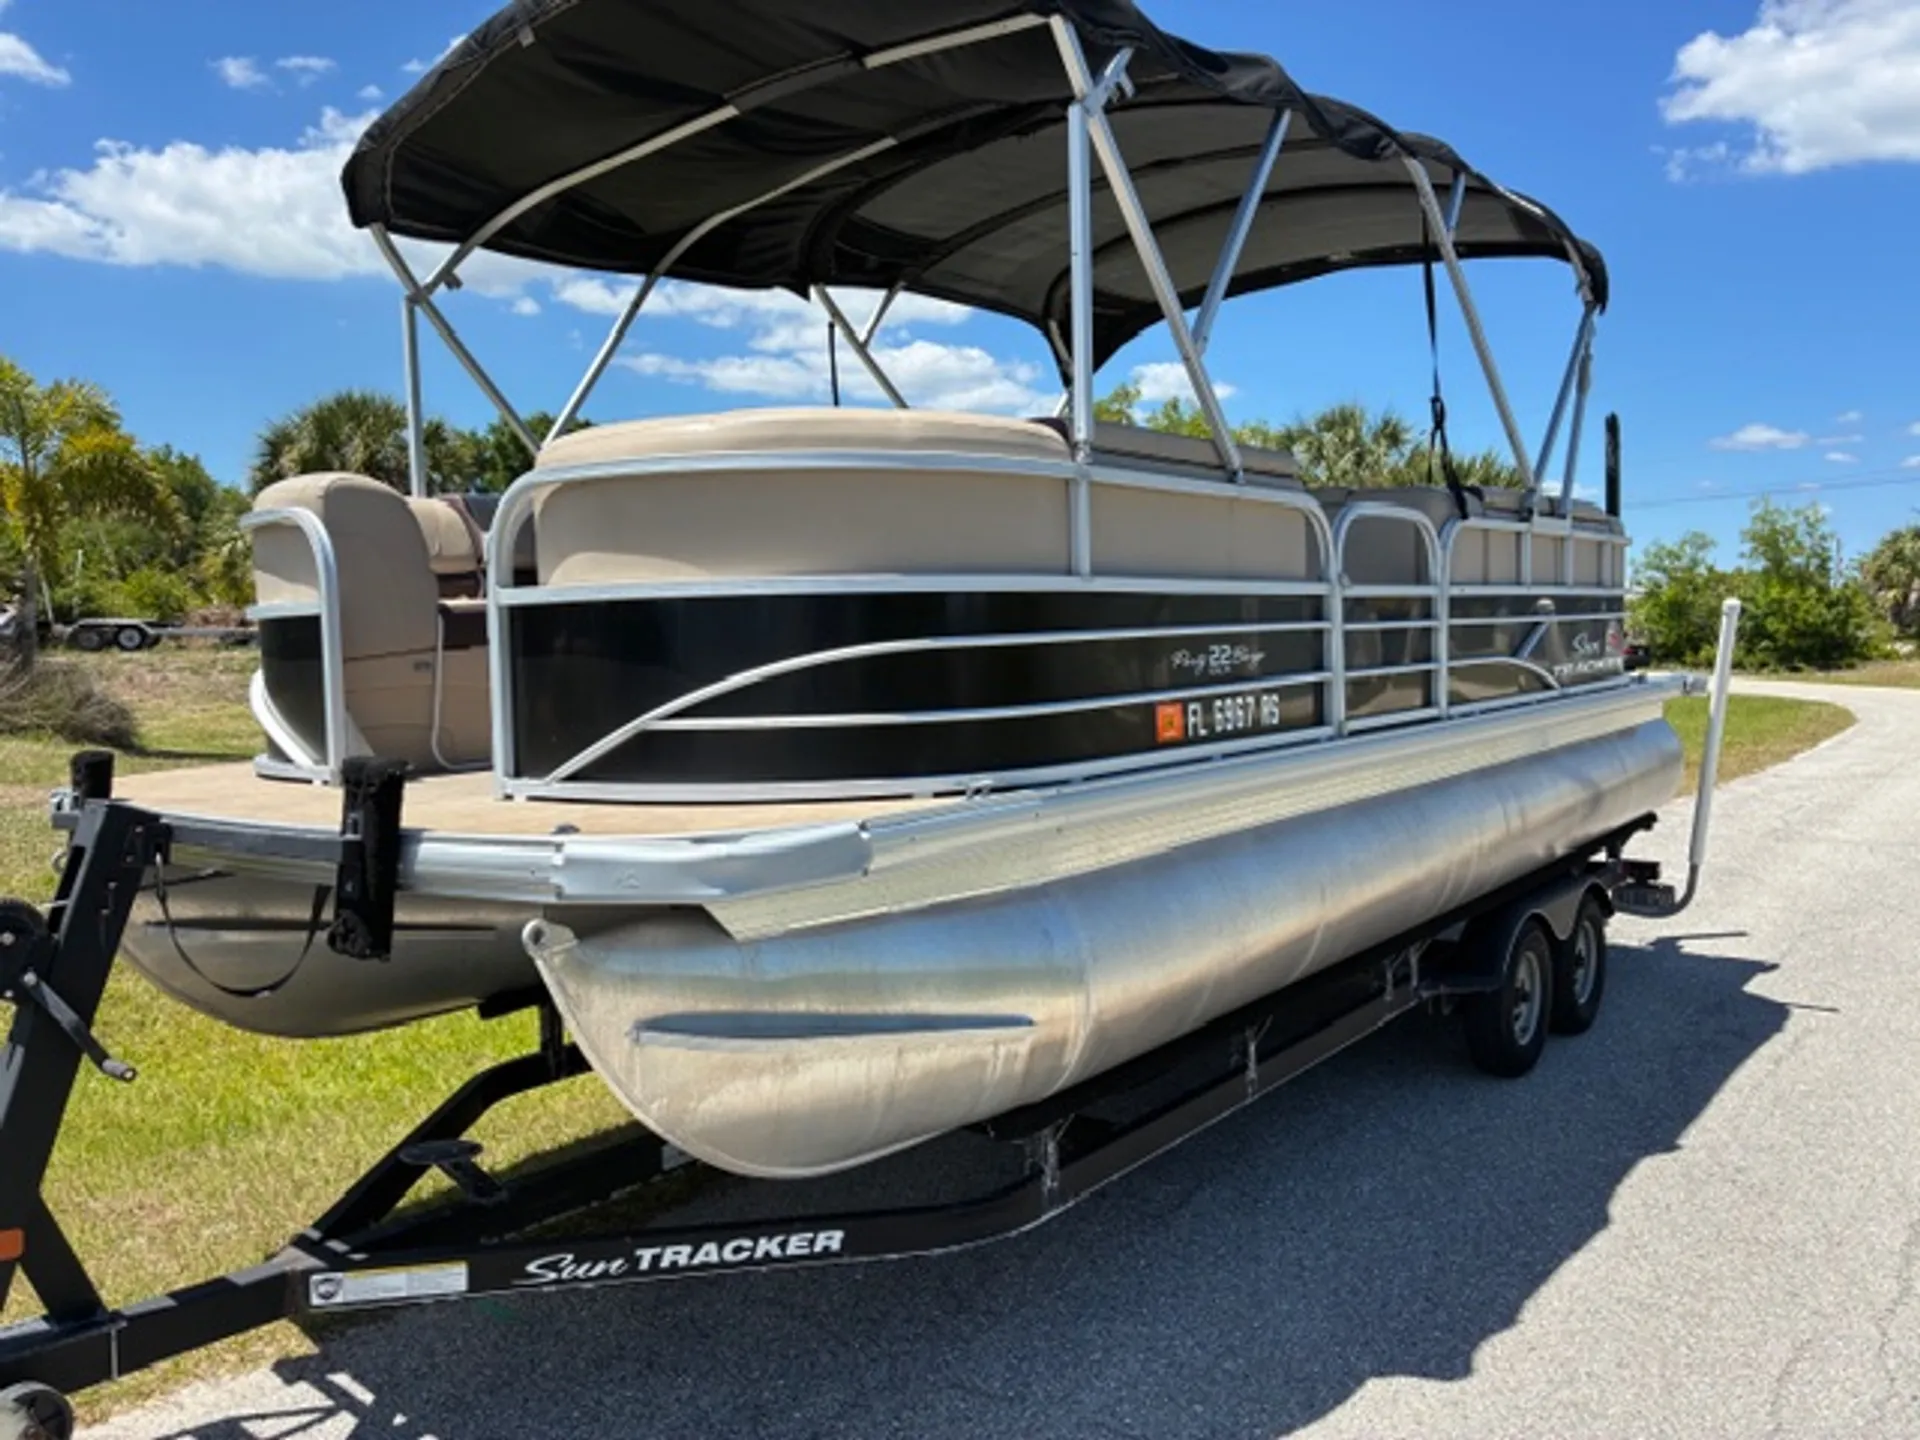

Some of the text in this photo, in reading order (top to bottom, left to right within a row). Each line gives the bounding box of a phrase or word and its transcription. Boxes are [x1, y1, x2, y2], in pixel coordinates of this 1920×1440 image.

[1208, 644, 1232, 667] 22
[1187, 702, 1208, 737] FL
[518, 1229, 846, 1284] Sun TRACKER
